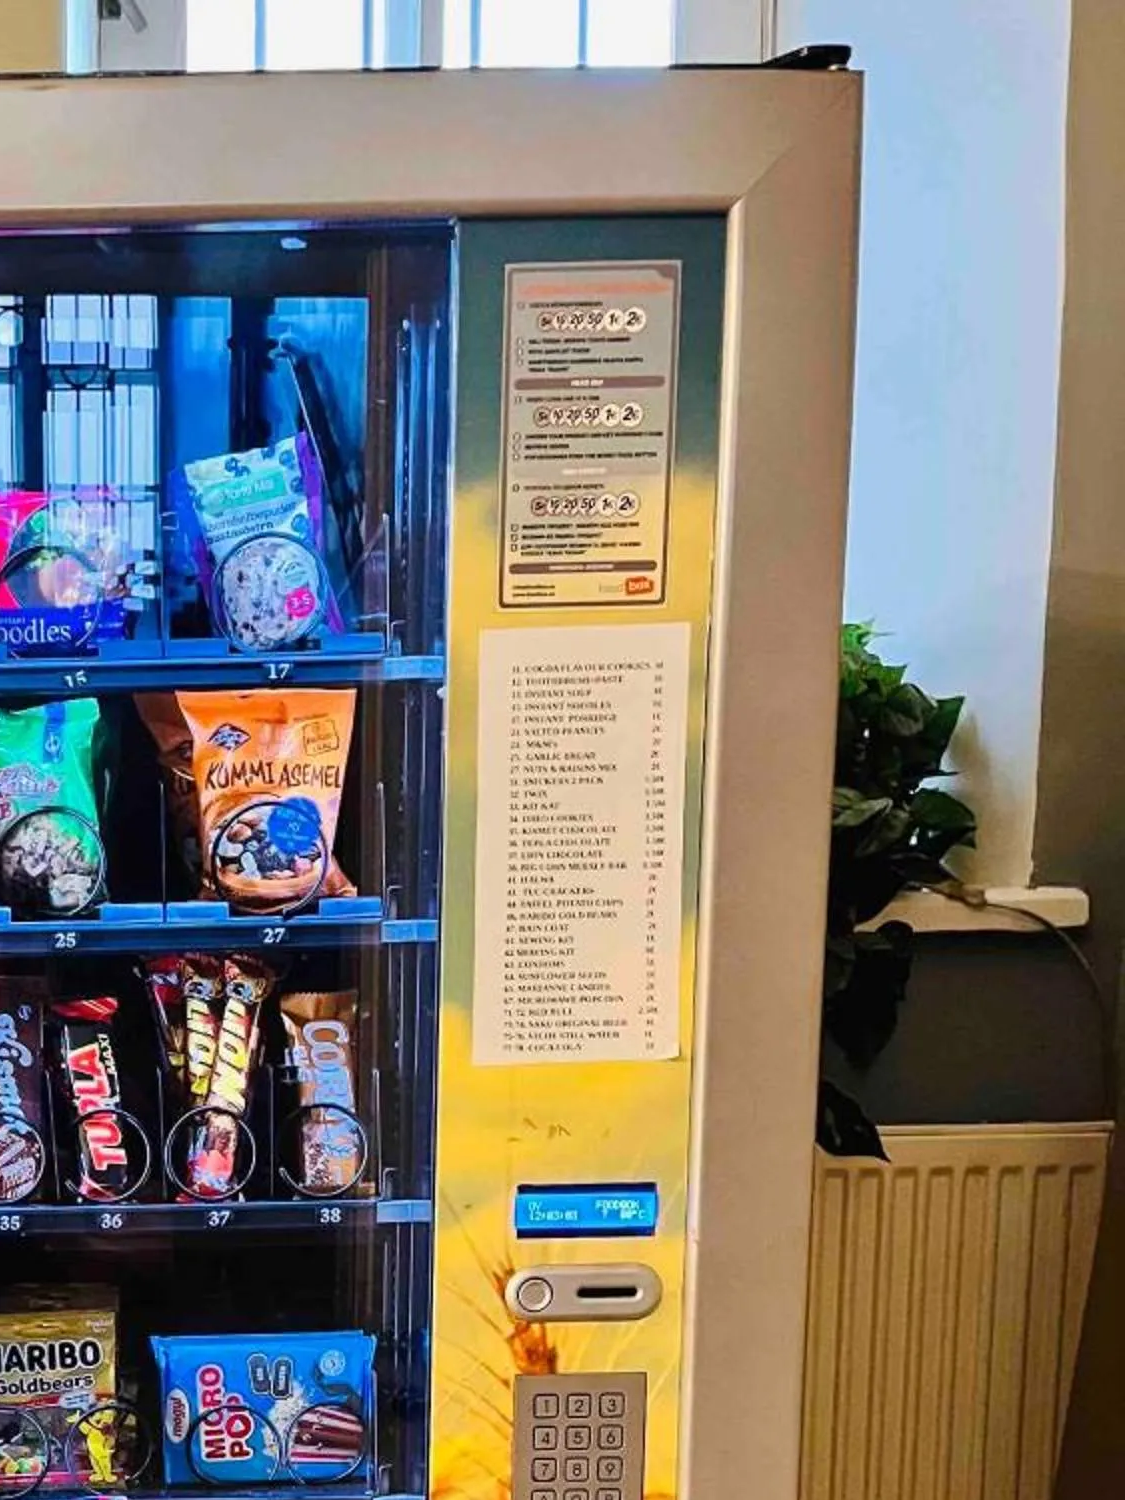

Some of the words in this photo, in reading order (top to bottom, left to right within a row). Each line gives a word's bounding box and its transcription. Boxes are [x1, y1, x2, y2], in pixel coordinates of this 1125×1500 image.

[266, 664, 290, 680] 17
[204, 758, 276, 790] KUMMI
[278, 762, 343, 790] ASEMEL
[54, 934, 76, 948] 25
[263, 928, 285, 943] 27
[67, 1042, 128, 1172] TUPLA
[0, 1215, 22, 1231] 35
[100, 1212, 123, 1229] 36
[208, 1210, 231, 1227] 37
[320, 1207, 342, 1224] 38
[198, 1366, 226, 1460] MICRO
[543, 1400, 550, 1412] 1
[573, 1400, 584, 1413] 2
[606, 1399, 617, 1413] 3
[225, 1395, 253, 1459] POP
[540, 1431, 551, 1445] 4
[572, 1431, 584, 1445] 5
[605, 1430, 616, 1445] 6
[540, 1462, 551, 1476] 7
[572, 1463, 582, 1477] 8
[604, 1462, 616, 1475] 9
